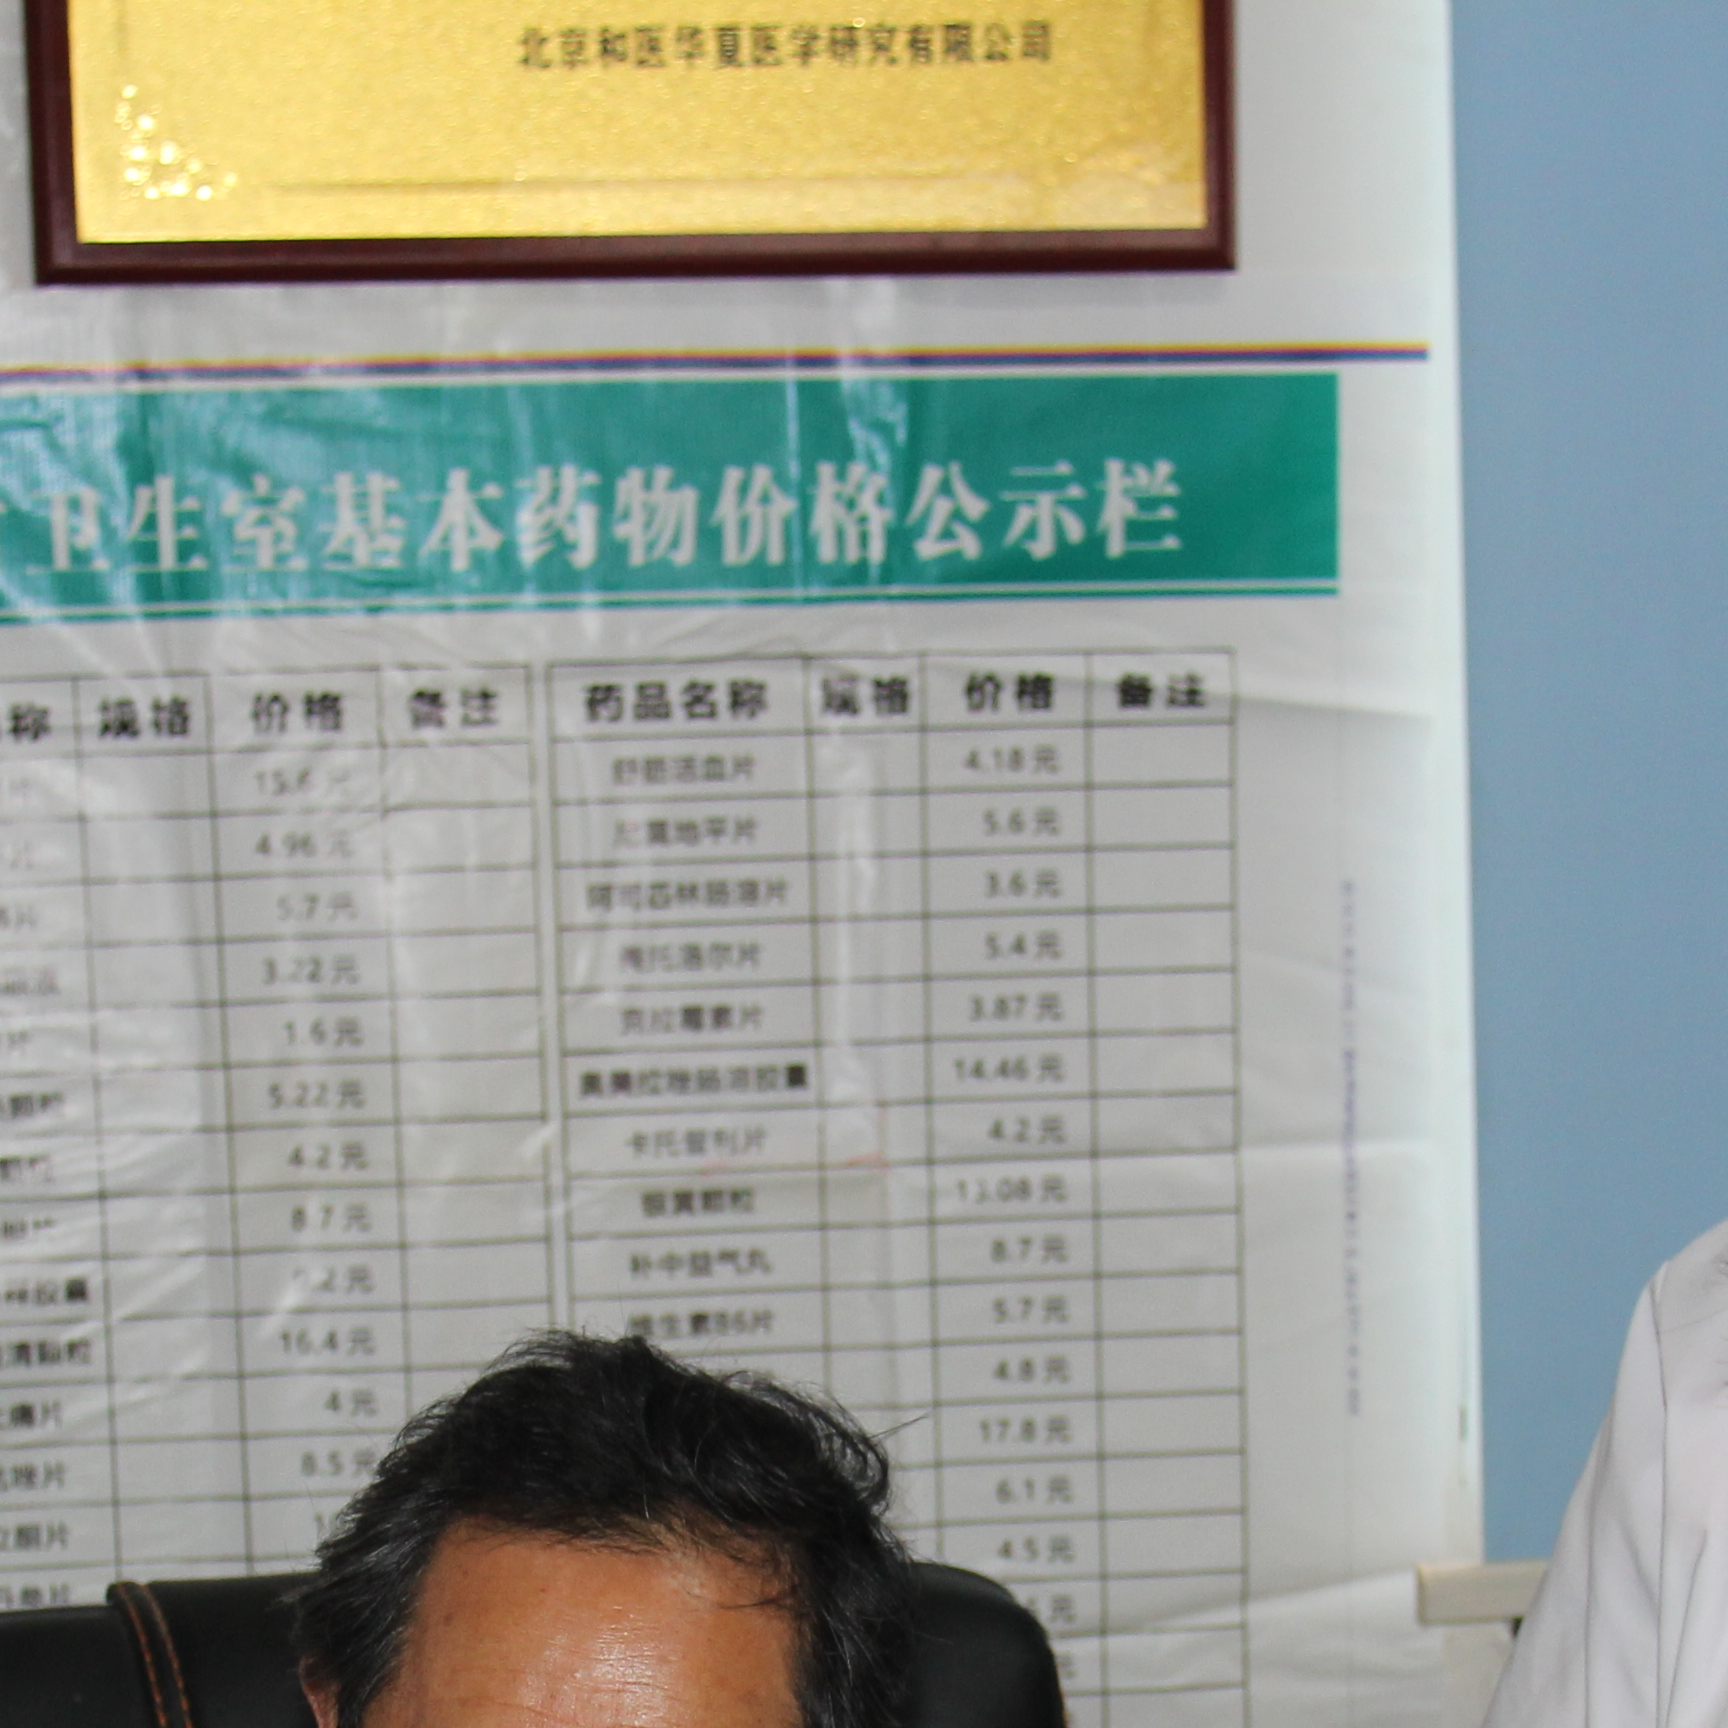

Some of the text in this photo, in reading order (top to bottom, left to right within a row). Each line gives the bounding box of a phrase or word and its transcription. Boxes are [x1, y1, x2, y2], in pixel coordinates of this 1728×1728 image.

[584, 681, 767, 723] 药品名称
[964, 673, 1055, 714] 价格
[1117, 671, 1205, 710] 备注
[250, 691, 345, 733] 价格
[985, 931, 1063, 962] 5.4元
[266, 1081, 368, 1110] 5.22元
[987, 1115, 1068, 1145] 4.2元
[288, 1141, 371, 1171] 4.2元
[990, 1236, 1070, 1266] 8.7元
[991, 1296, 1072, 1326] 5.7元
[278, 1328, 377, 1356] 16.4元
[991, 1355, 1073, 1385] 4.8元
[324, 1388, 378, 1417] 4元
[978, 1415, 1074, 1445] 17.8元
[995, 1476, 1075, 1506] 6.1元
[996, 1534, 1076, 1565] 4.5元
